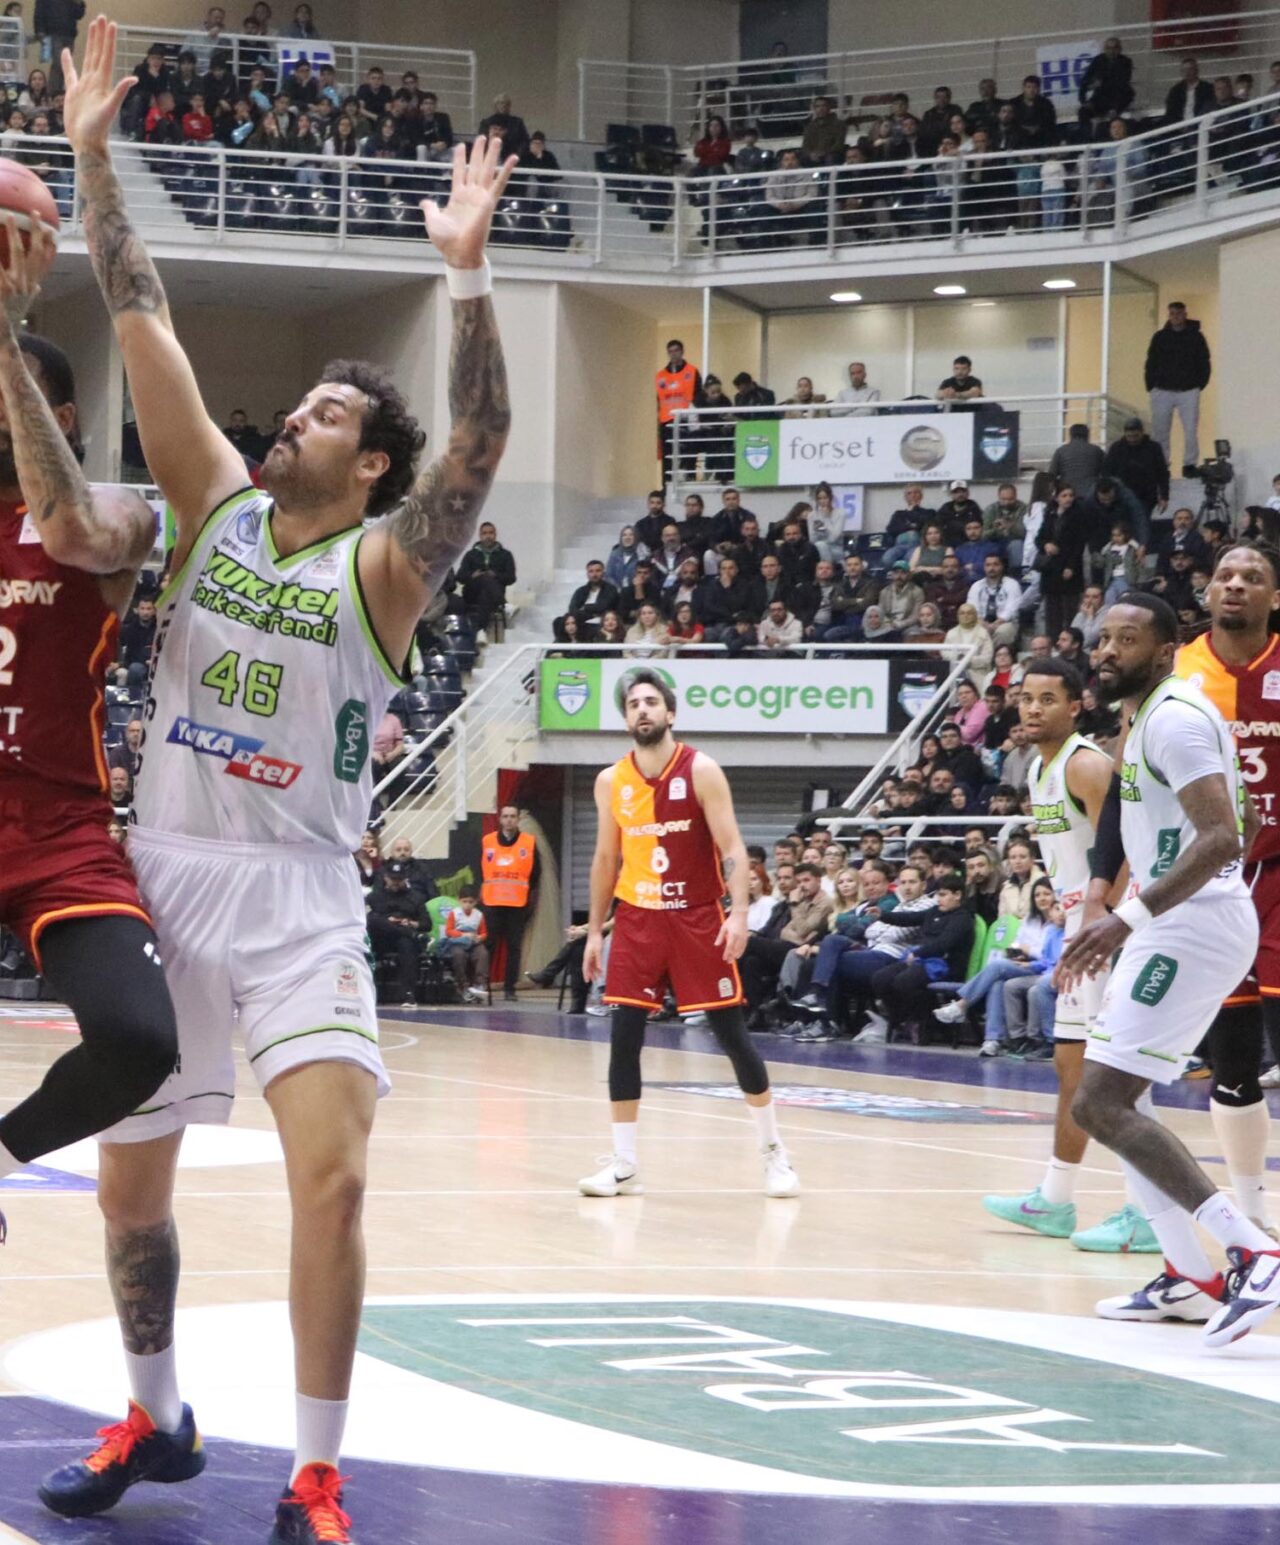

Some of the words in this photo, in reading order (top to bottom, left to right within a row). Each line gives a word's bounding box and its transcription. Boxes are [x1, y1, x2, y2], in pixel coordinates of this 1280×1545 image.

[789, 436, 875, 460] forset
[191, 580, 338, 647] erkezefendi
[202, 650, 284, 717] 46
[685, 684, 874, 719] ecogreen
[341, 709, 365, 774] ABALI
[249, 760, 296, 784] tel
[651, 846, 670, 874] 8
[1139, 960, 1170, 1001] ABALI
